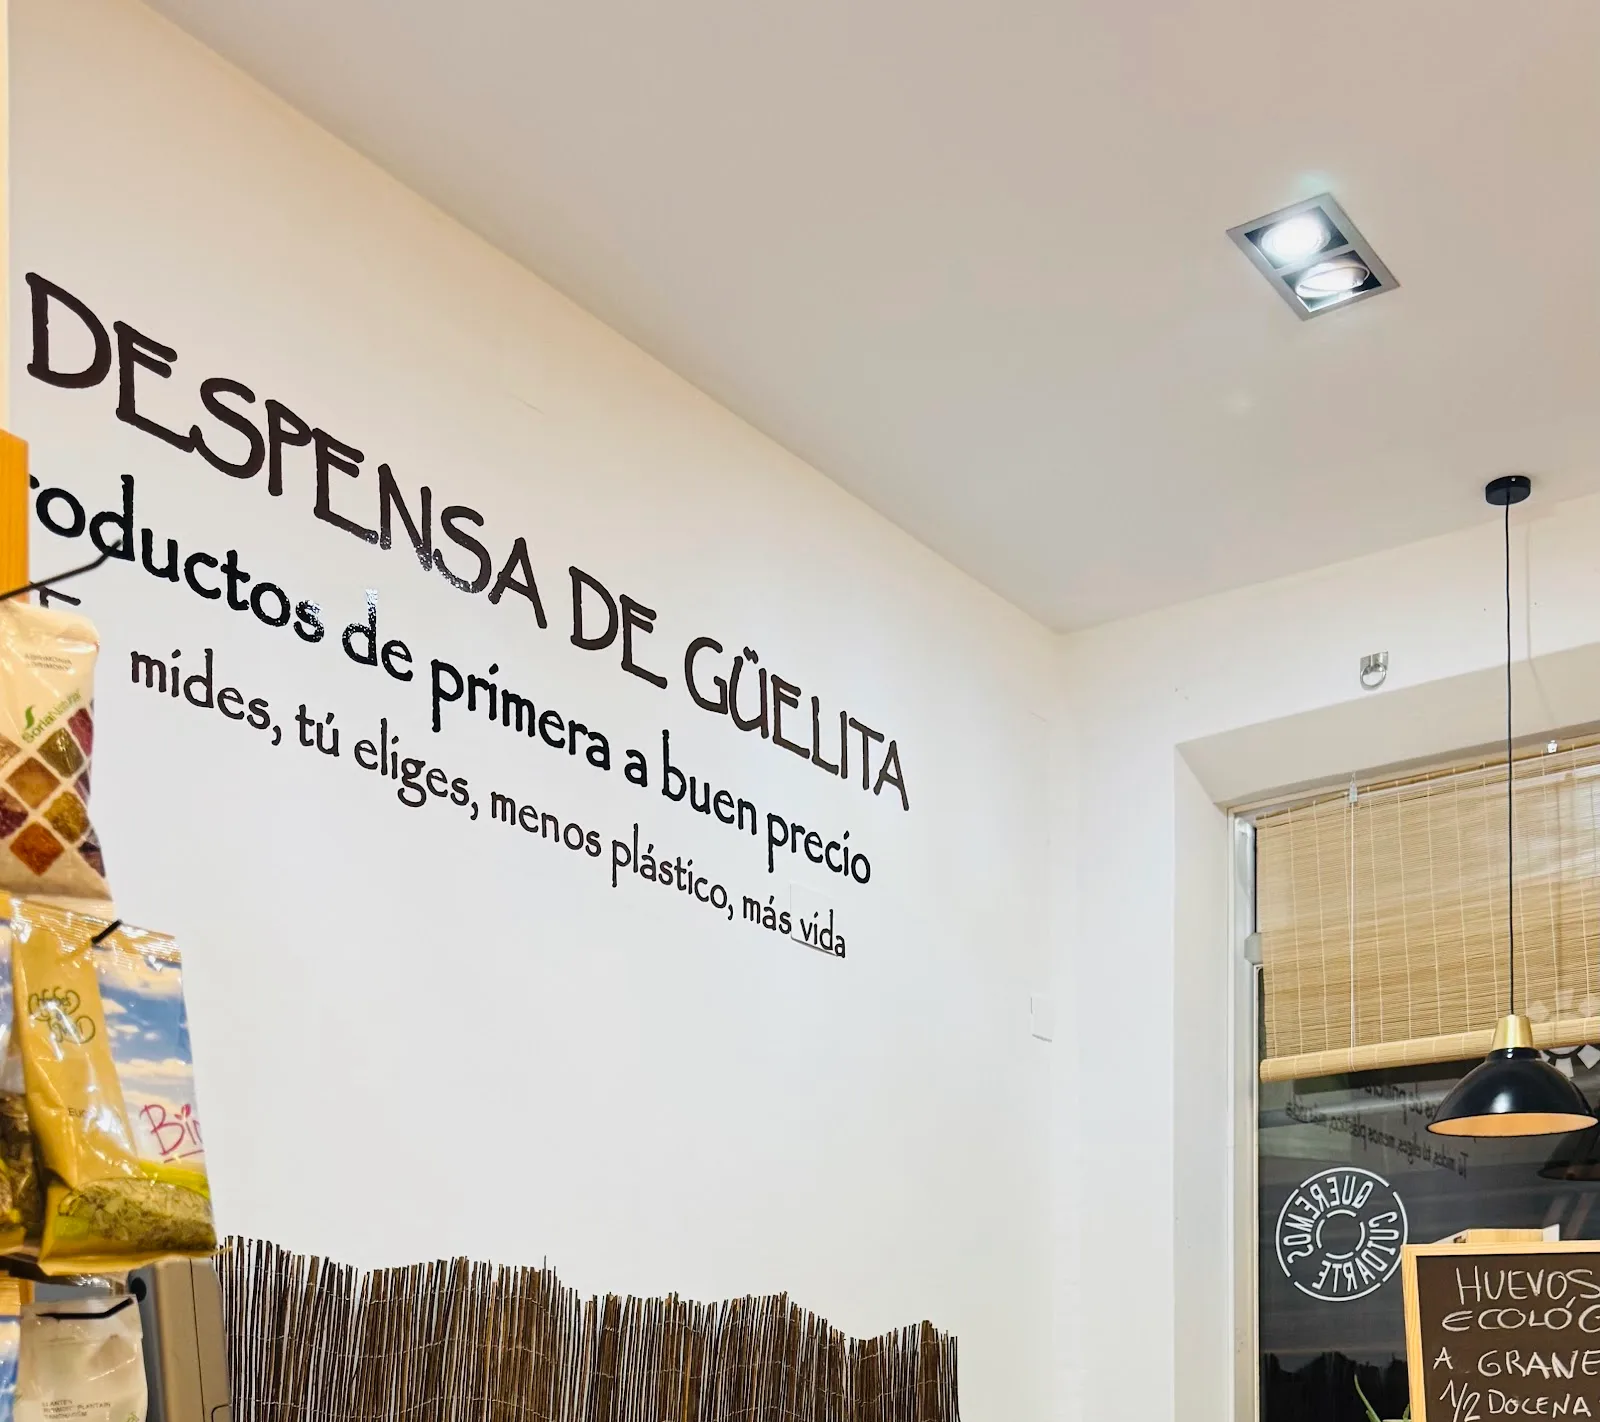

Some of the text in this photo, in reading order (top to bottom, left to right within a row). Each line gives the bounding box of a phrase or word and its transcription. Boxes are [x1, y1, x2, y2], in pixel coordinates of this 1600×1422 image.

[25, 272, 909, 811] DESPENSA DE GÜELITA
[28, 473, 871, 884] oductos de primera a buen precio
[295, 704, 339, 758] tú
[353, 717, 478, 821] eliges,
[490, 790, 601, 858] menos
[612, 823, 734, 920] plástico,
[742, 894, 792, 935] más
[800, 909, 846, 958] vida
[1433, 1346, 1453, 1371] A
[1456, 1265, 1600, 1305] HUEVOS
